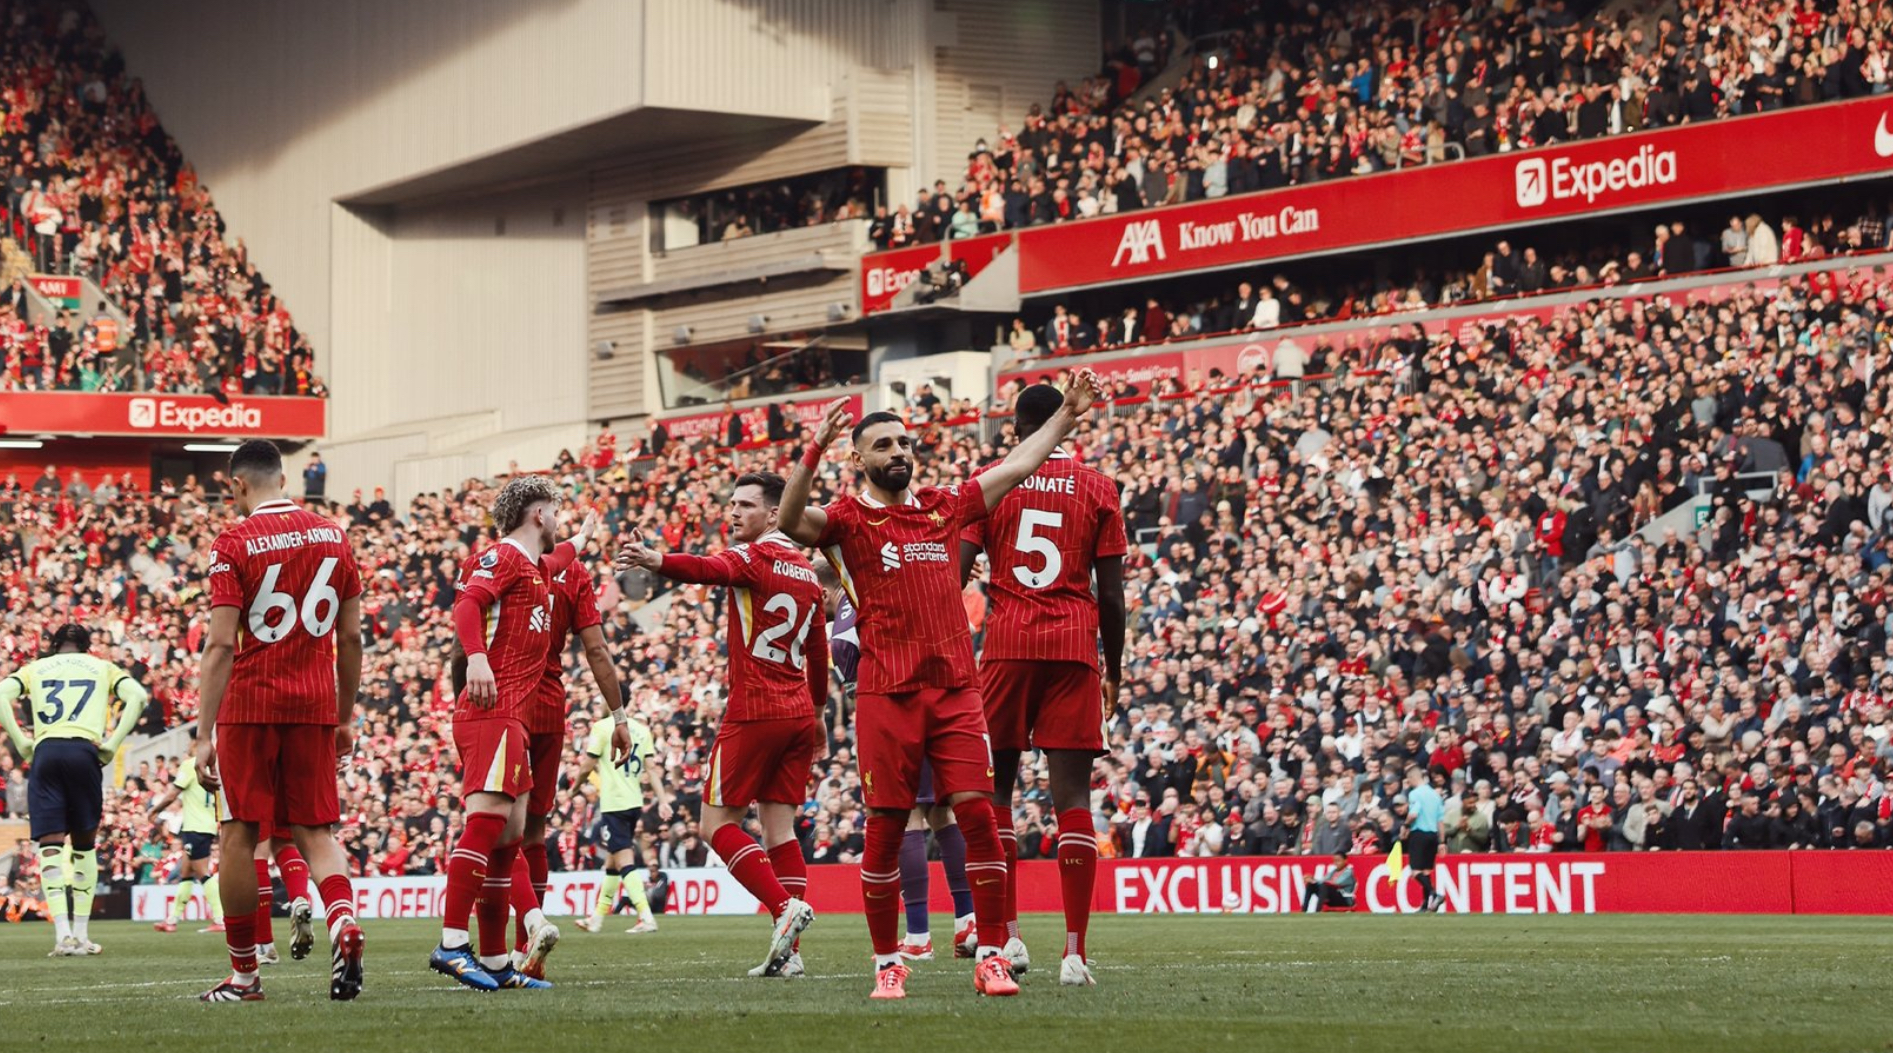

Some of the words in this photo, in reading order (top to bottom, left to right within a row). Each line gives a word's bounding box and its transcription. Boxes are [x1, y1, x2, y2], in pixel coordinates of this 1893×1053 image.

[1551, 144, 1677, 204] Expedia
[1111, 218, 1167, 267] AXA
[1178, 221, 1236, 250] Know
[1238, 212, 1277, 241] You
[1279, 205, 1319, 235] Can
[159, 401, 262, 432] Expedia
[1019, 475, 1075, 494] ONATÉ
[246, 528, 343, 556] ALEXANDER-ARNOLD
[903, 541, 947, 553] standard
[1012, 508, 1063, 588] 5
[248, 557, 340, 644] 66
[37, 679, 96, 725] 37
[1065, 858, 1084, 866] LFC
[664, 879, 719, 915] APP
